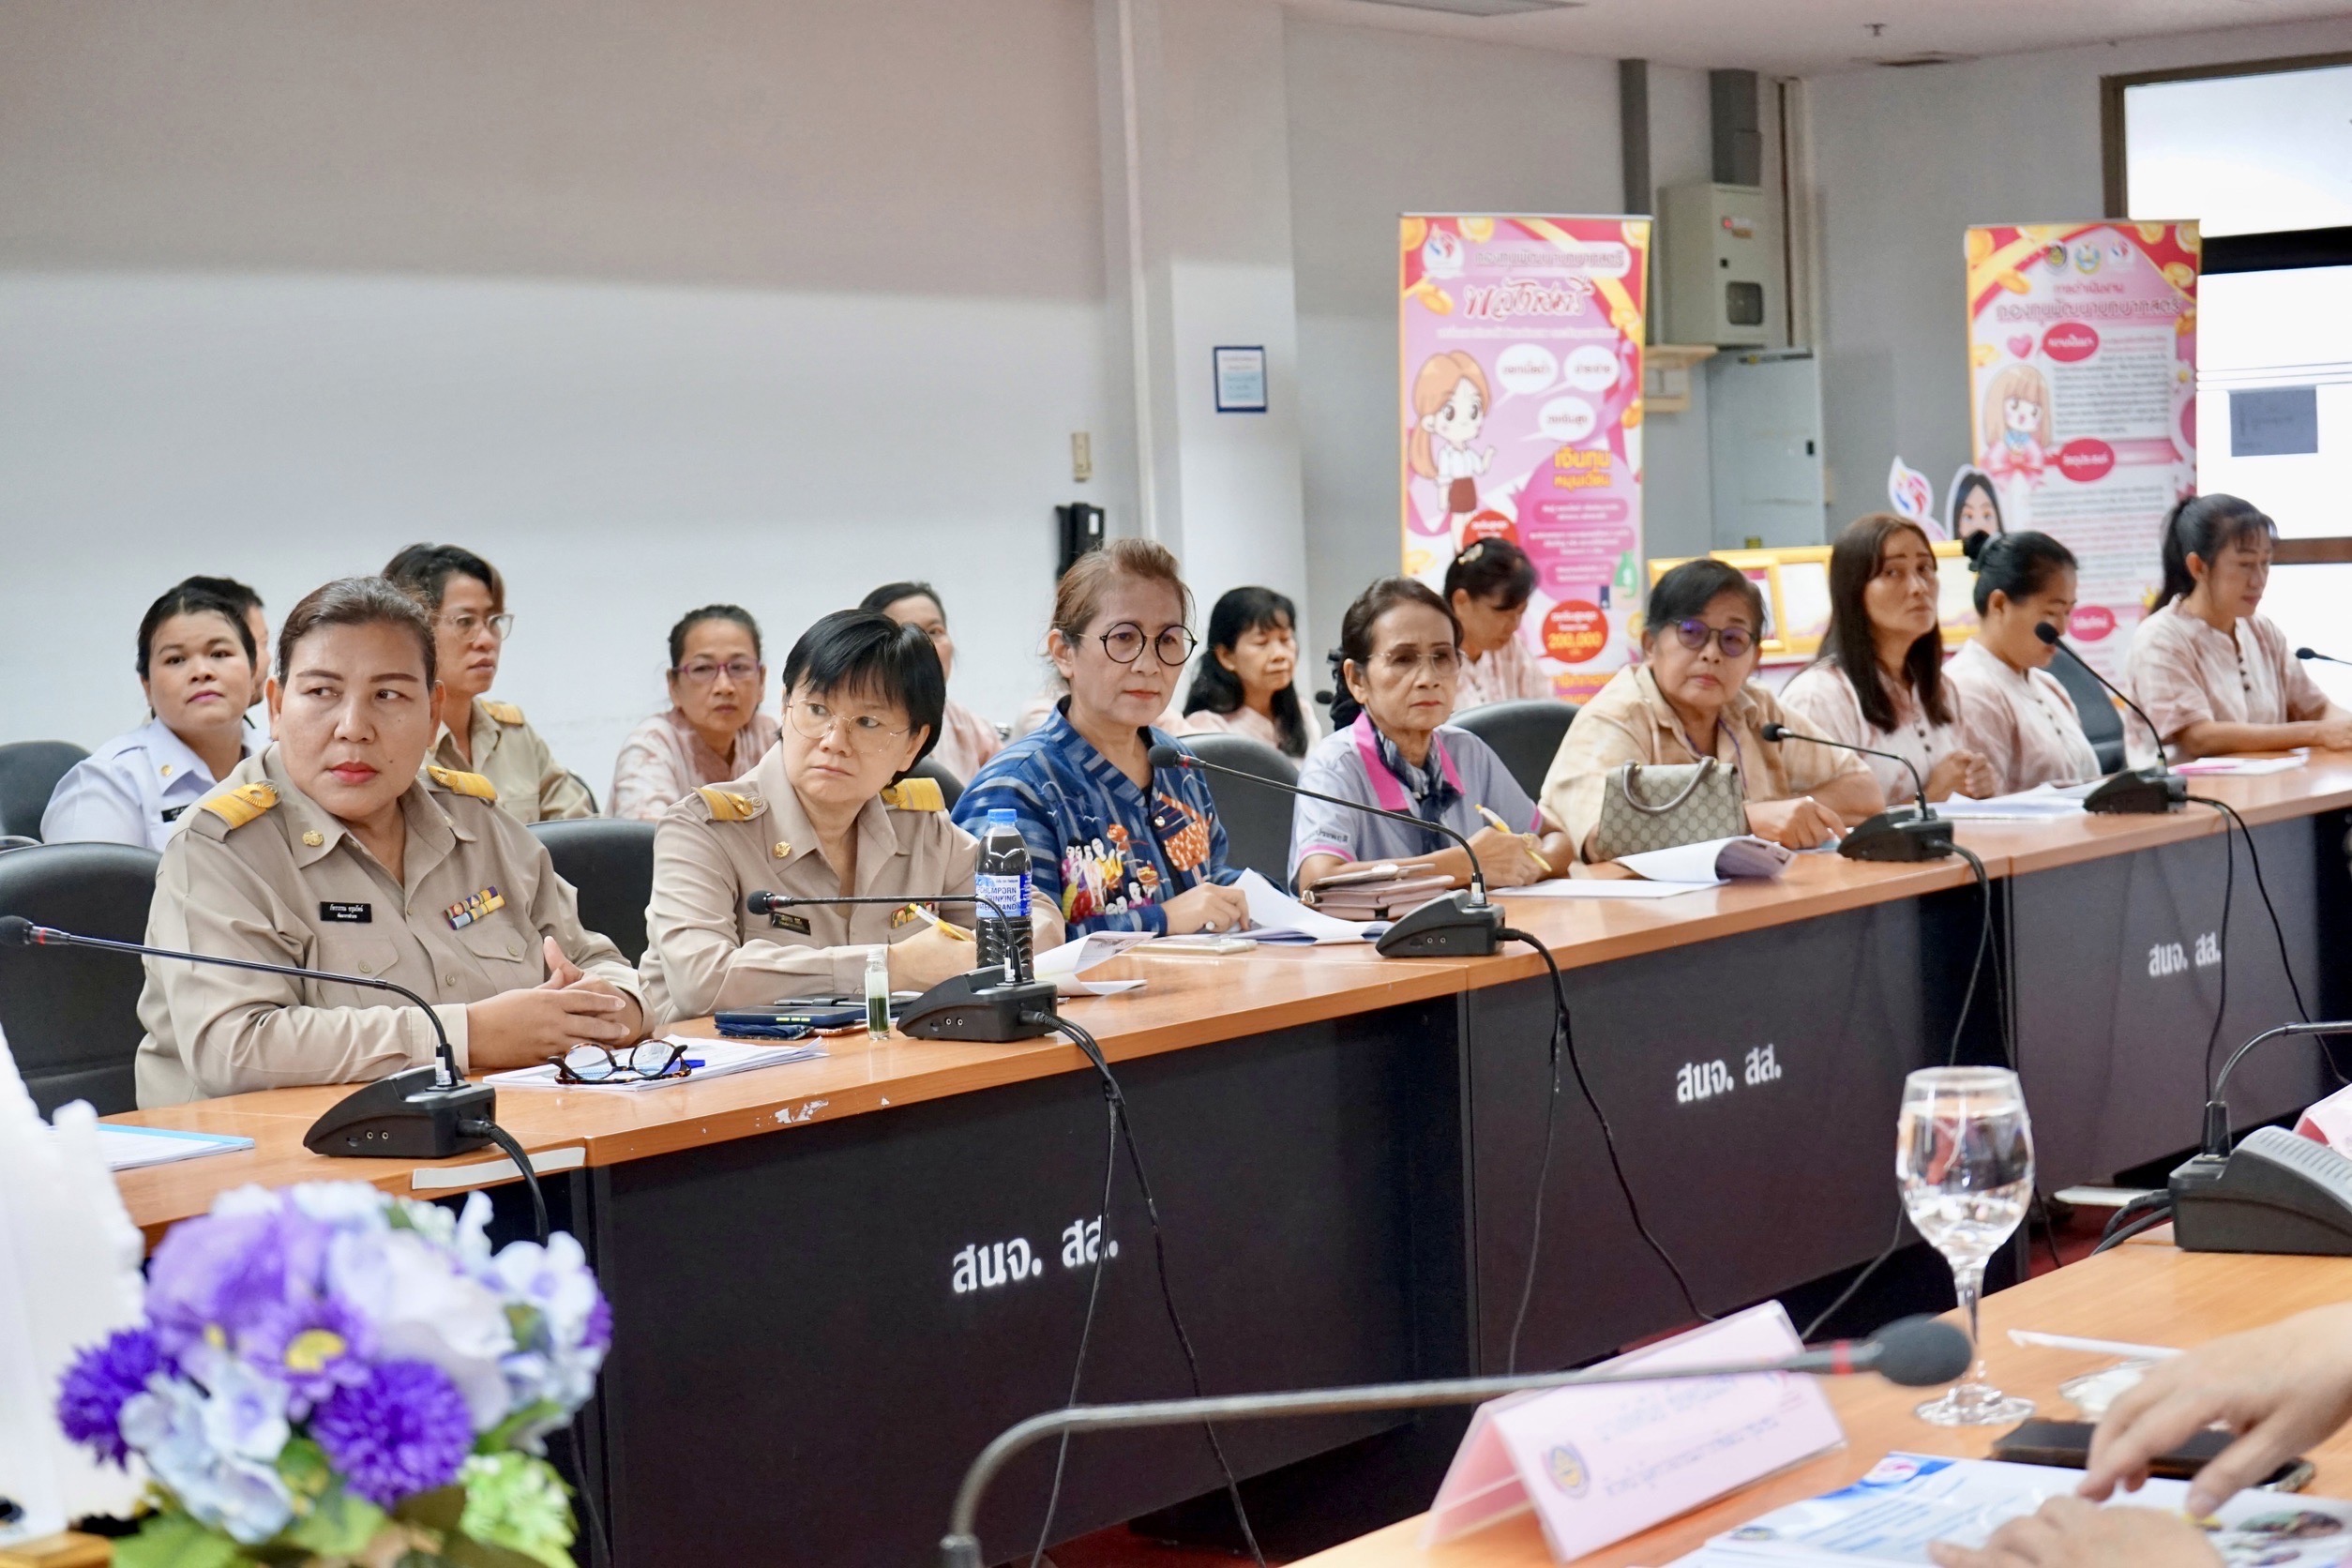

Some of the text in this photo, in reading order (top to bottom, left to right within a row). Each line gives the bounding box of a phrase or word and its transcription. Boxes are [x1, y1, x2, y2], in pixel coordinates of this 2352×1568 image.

[2148, 932, 2222, 977] สนจ. สส.
[1677, 1043, 1782, 1103] สนจ. สส.
[953, 1215, 1118, 1293] สนจ. สส.
